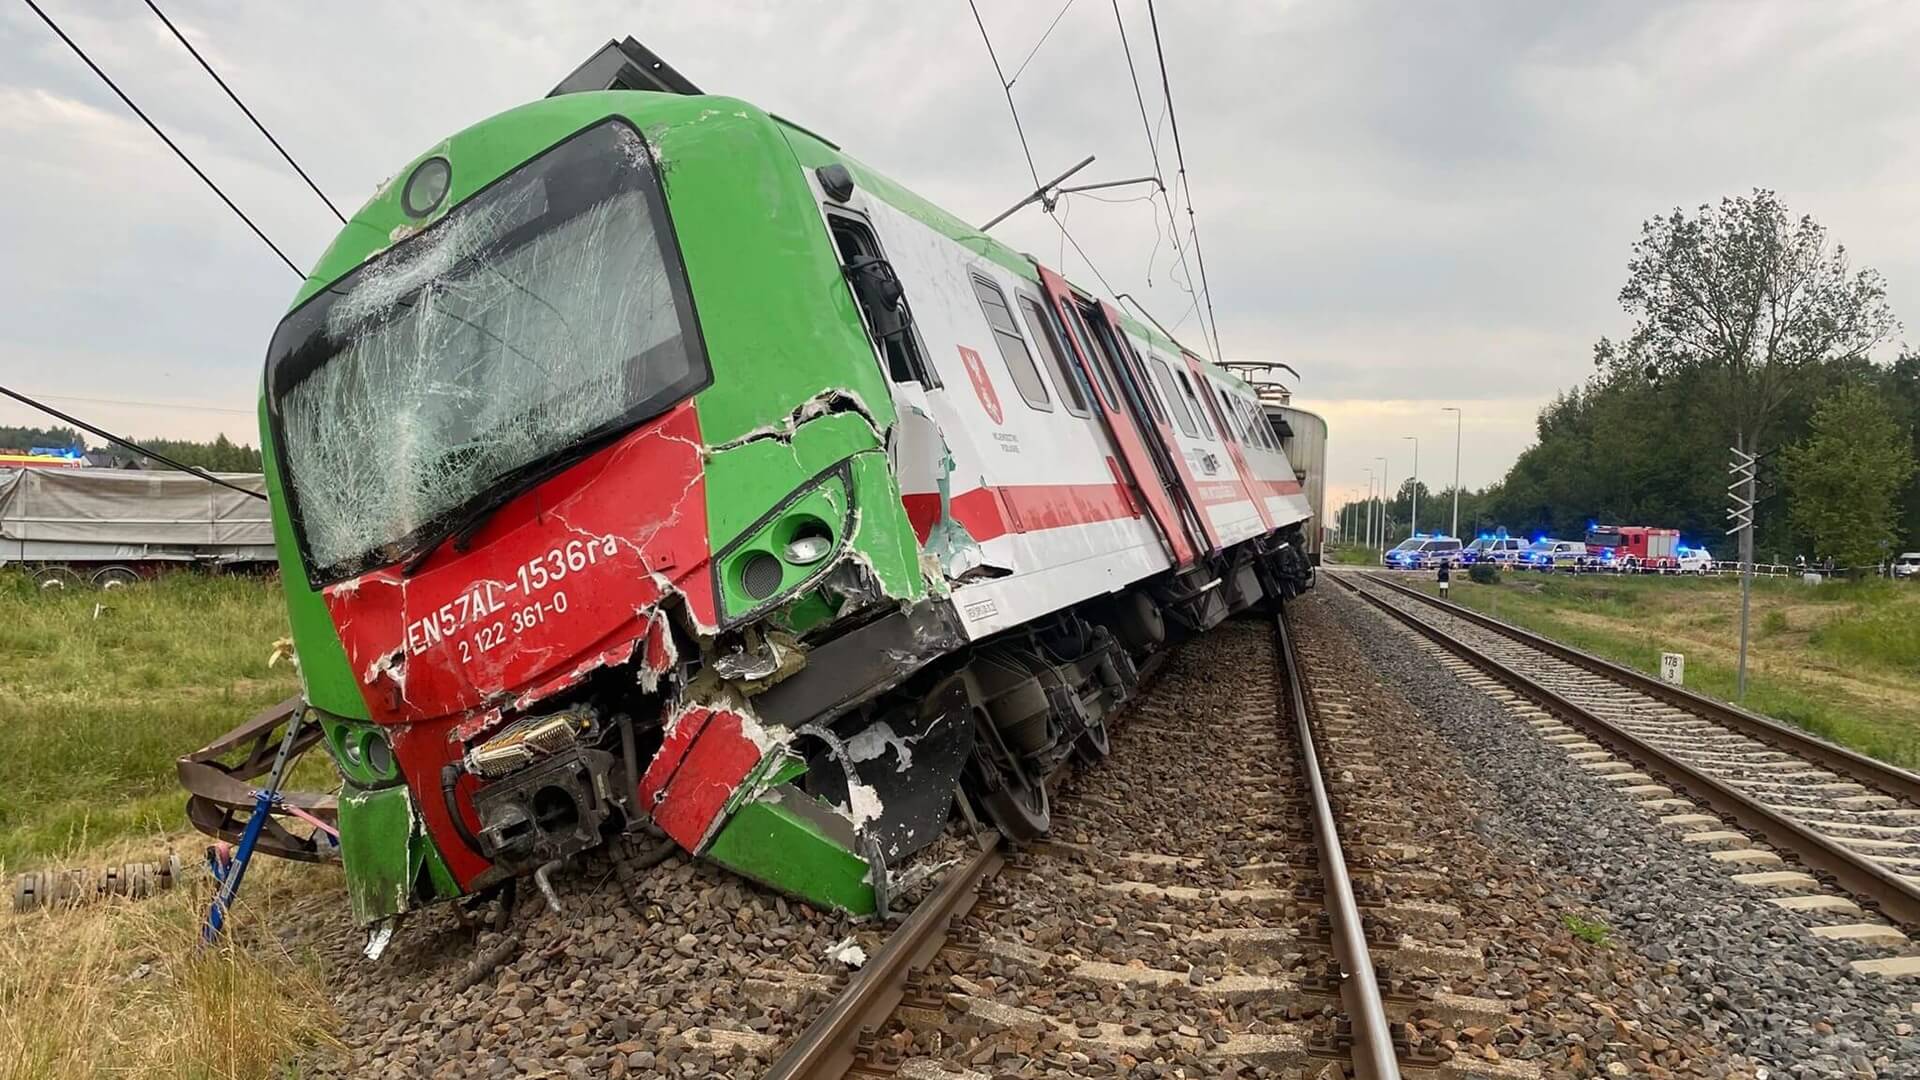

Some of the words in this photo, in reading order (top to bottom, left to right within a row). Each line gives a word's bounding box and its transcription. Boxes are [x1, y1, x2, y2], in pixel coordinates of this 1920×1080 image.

[407, 534, 618, 656] EN57AL-1536ra
[459, 641, 472, 664] 2
[474, 622, 506, 653] 122
[511, 592, 567, 634] 361-0
[1668, 669, 1674, 679] 3
